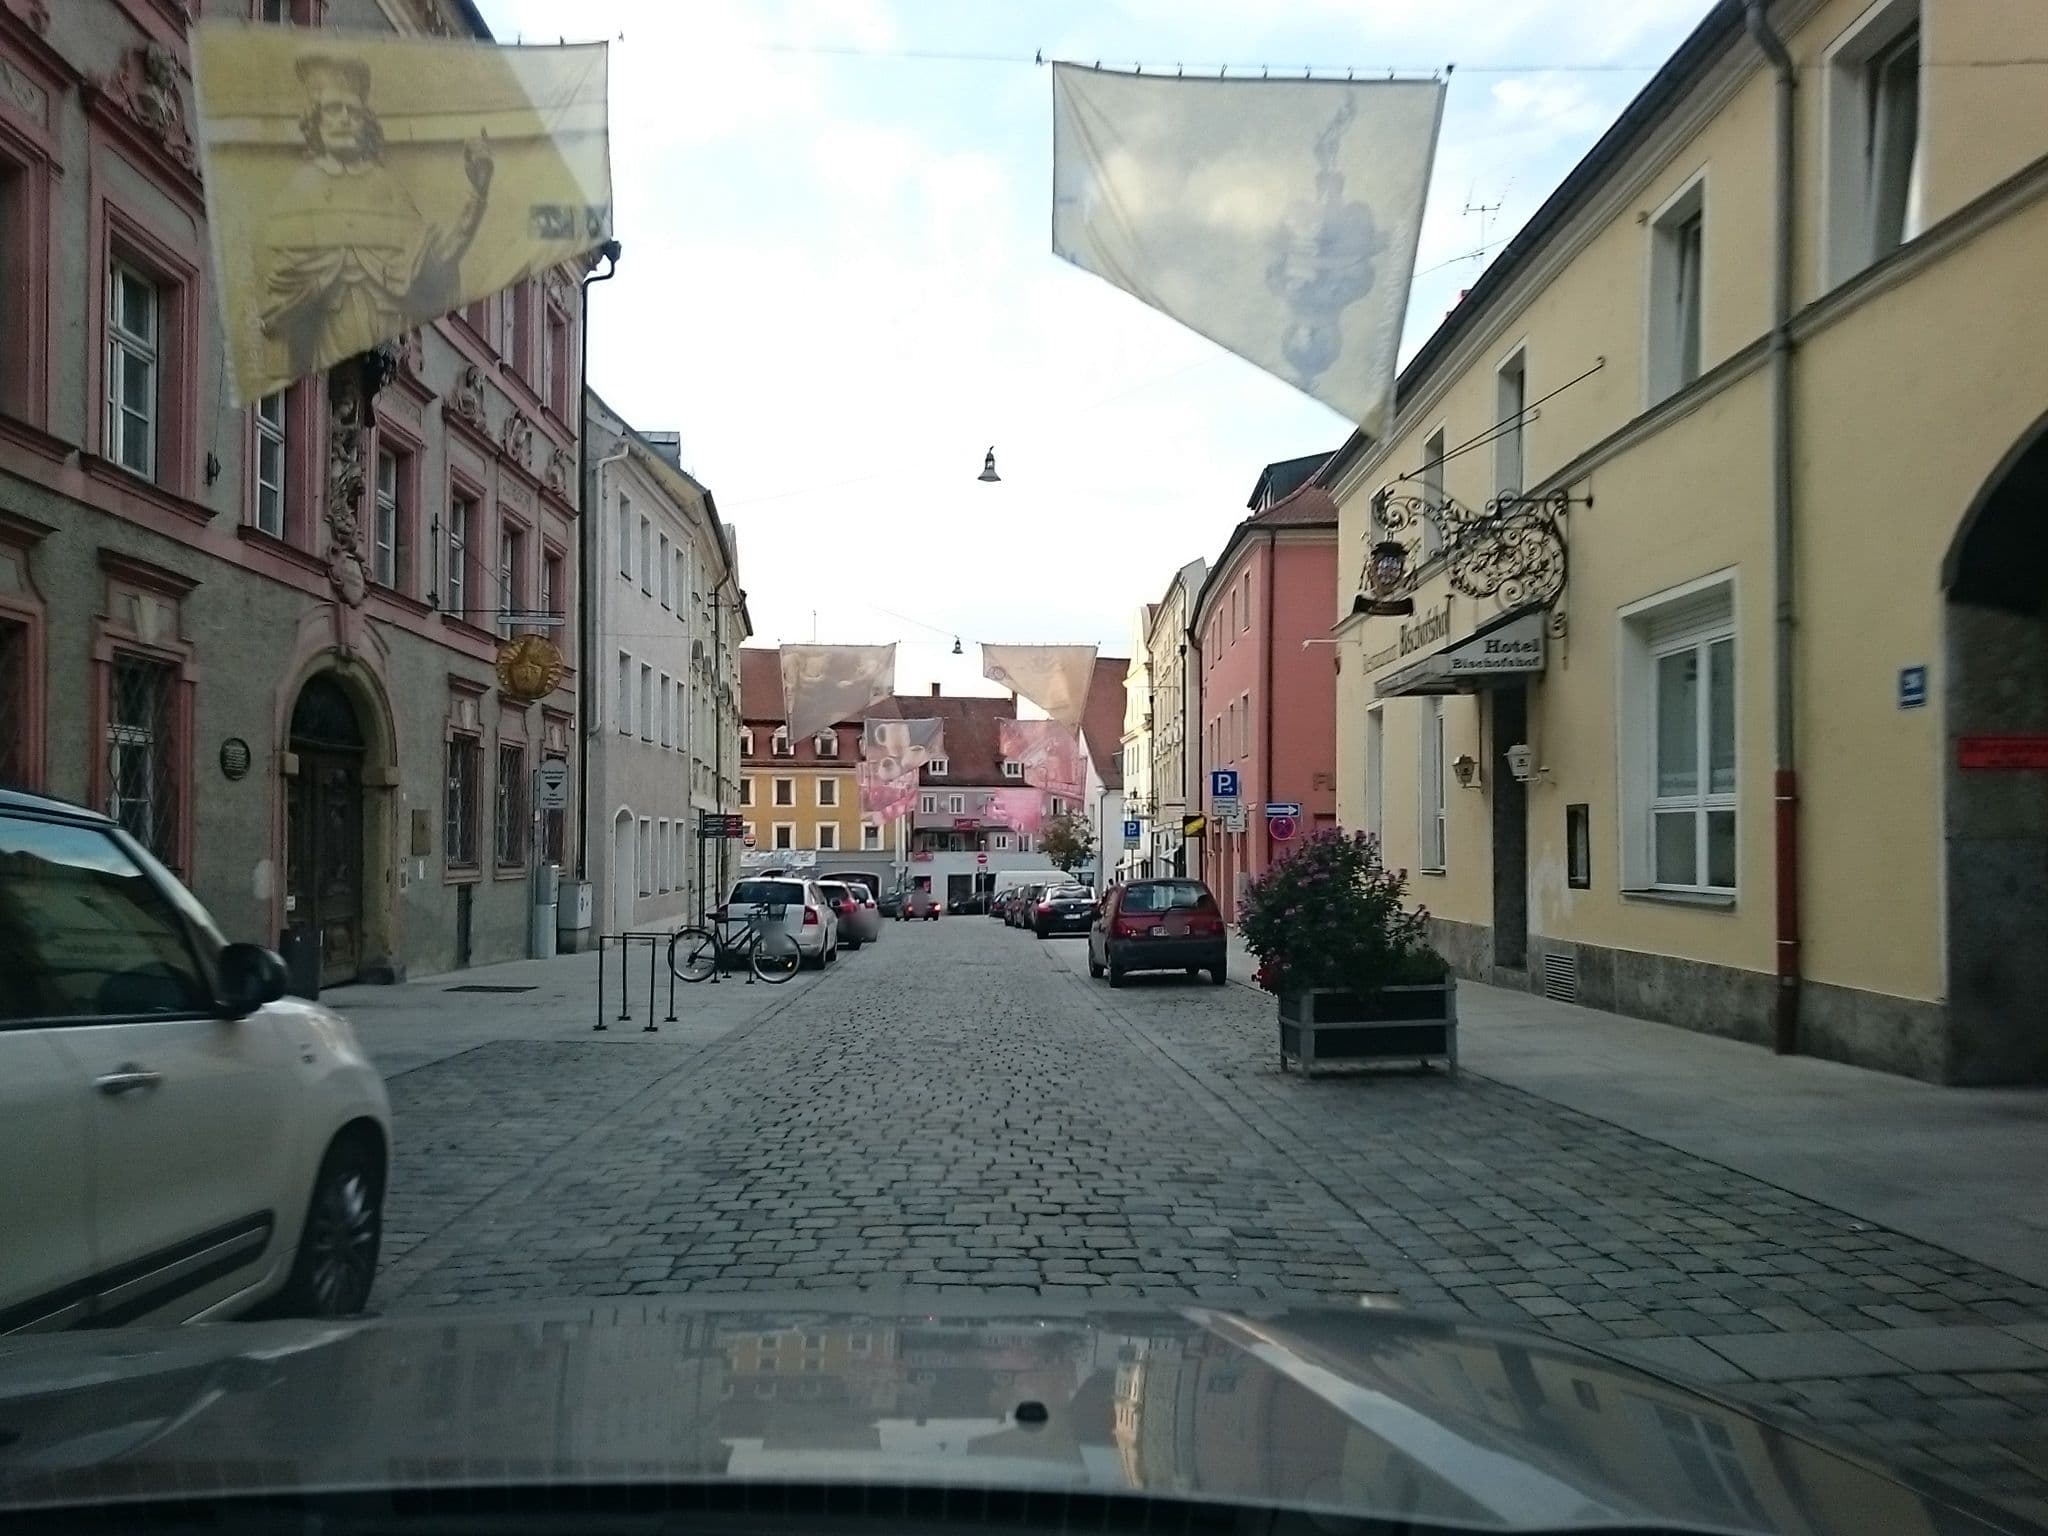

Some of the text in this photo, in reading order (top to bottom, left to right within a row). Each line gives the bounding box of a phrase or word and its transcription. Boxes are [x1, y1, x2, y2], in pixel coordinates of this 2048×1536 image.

[1484, 638, 1540, 653] Hotel
[1217, 774, 1232, 794] P
[1127, 822, 1137, 835] P
